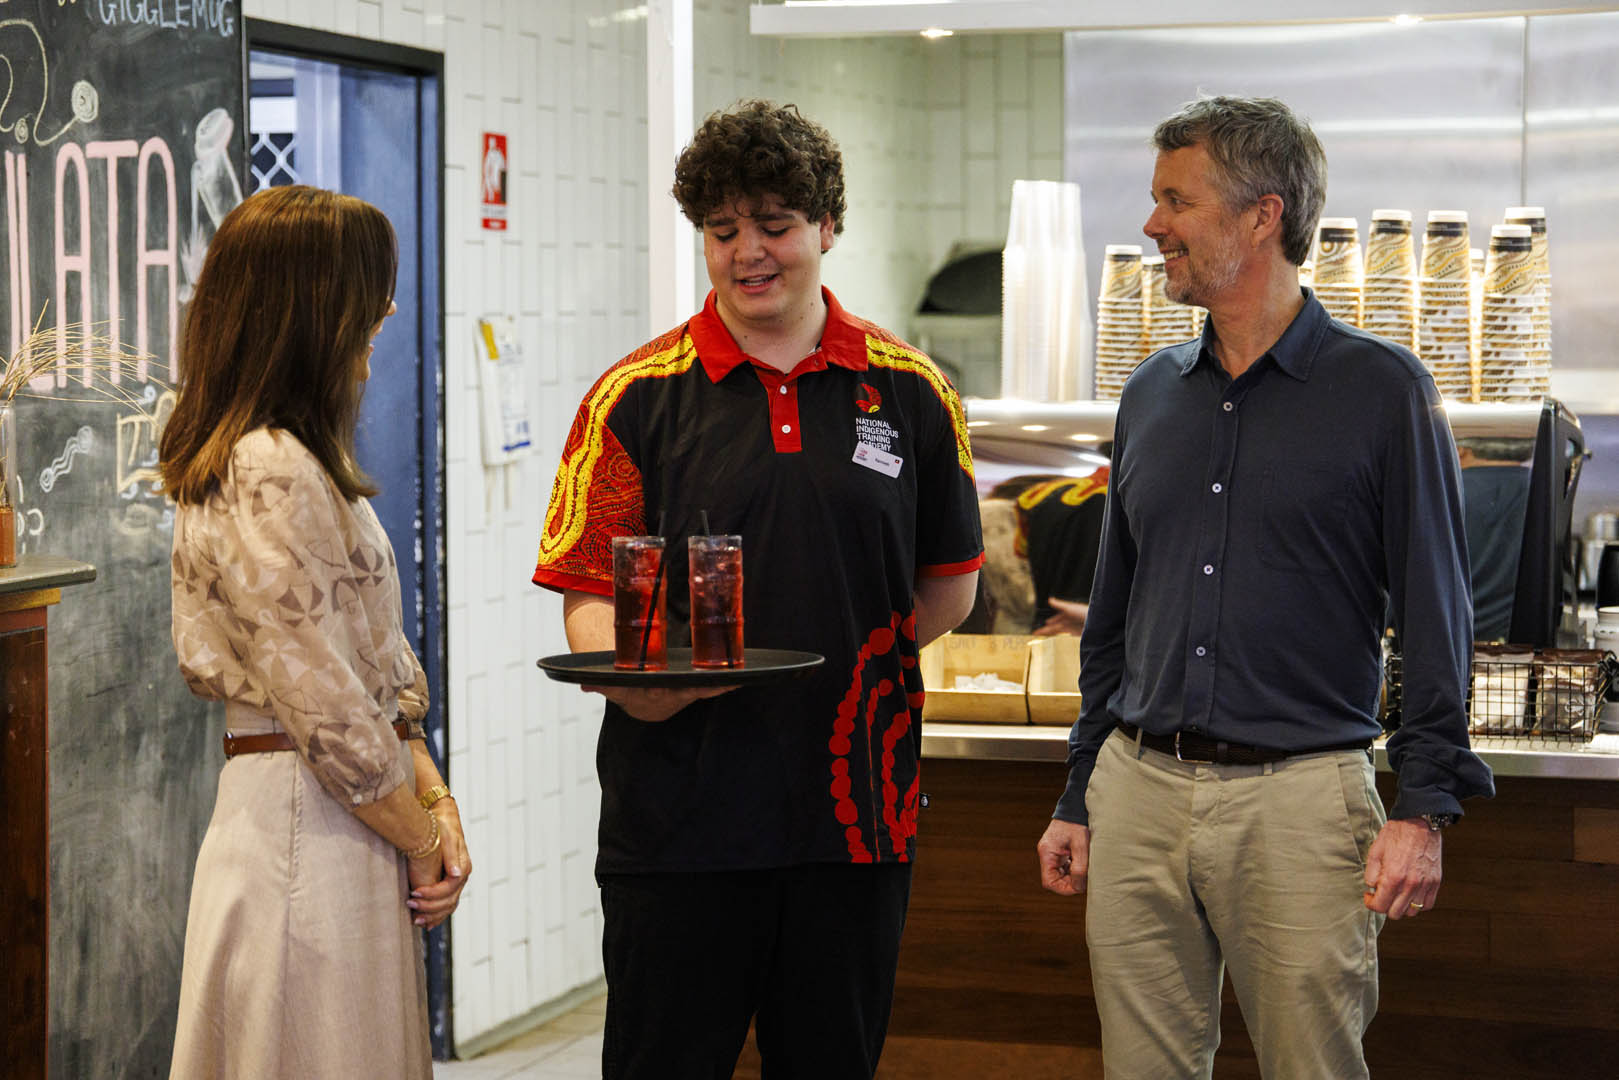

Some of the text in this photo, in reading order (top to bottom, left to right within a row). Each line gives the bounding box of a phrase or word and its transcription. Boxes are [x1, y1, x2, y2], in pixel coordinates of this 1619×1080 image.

[0, 137, 178, 392] LATA
[856, 417, 892, 429] NATIONAL
[856, 425, 899, 438] INDIGENOUS
[856, 432, 891, 445] TRAINING
